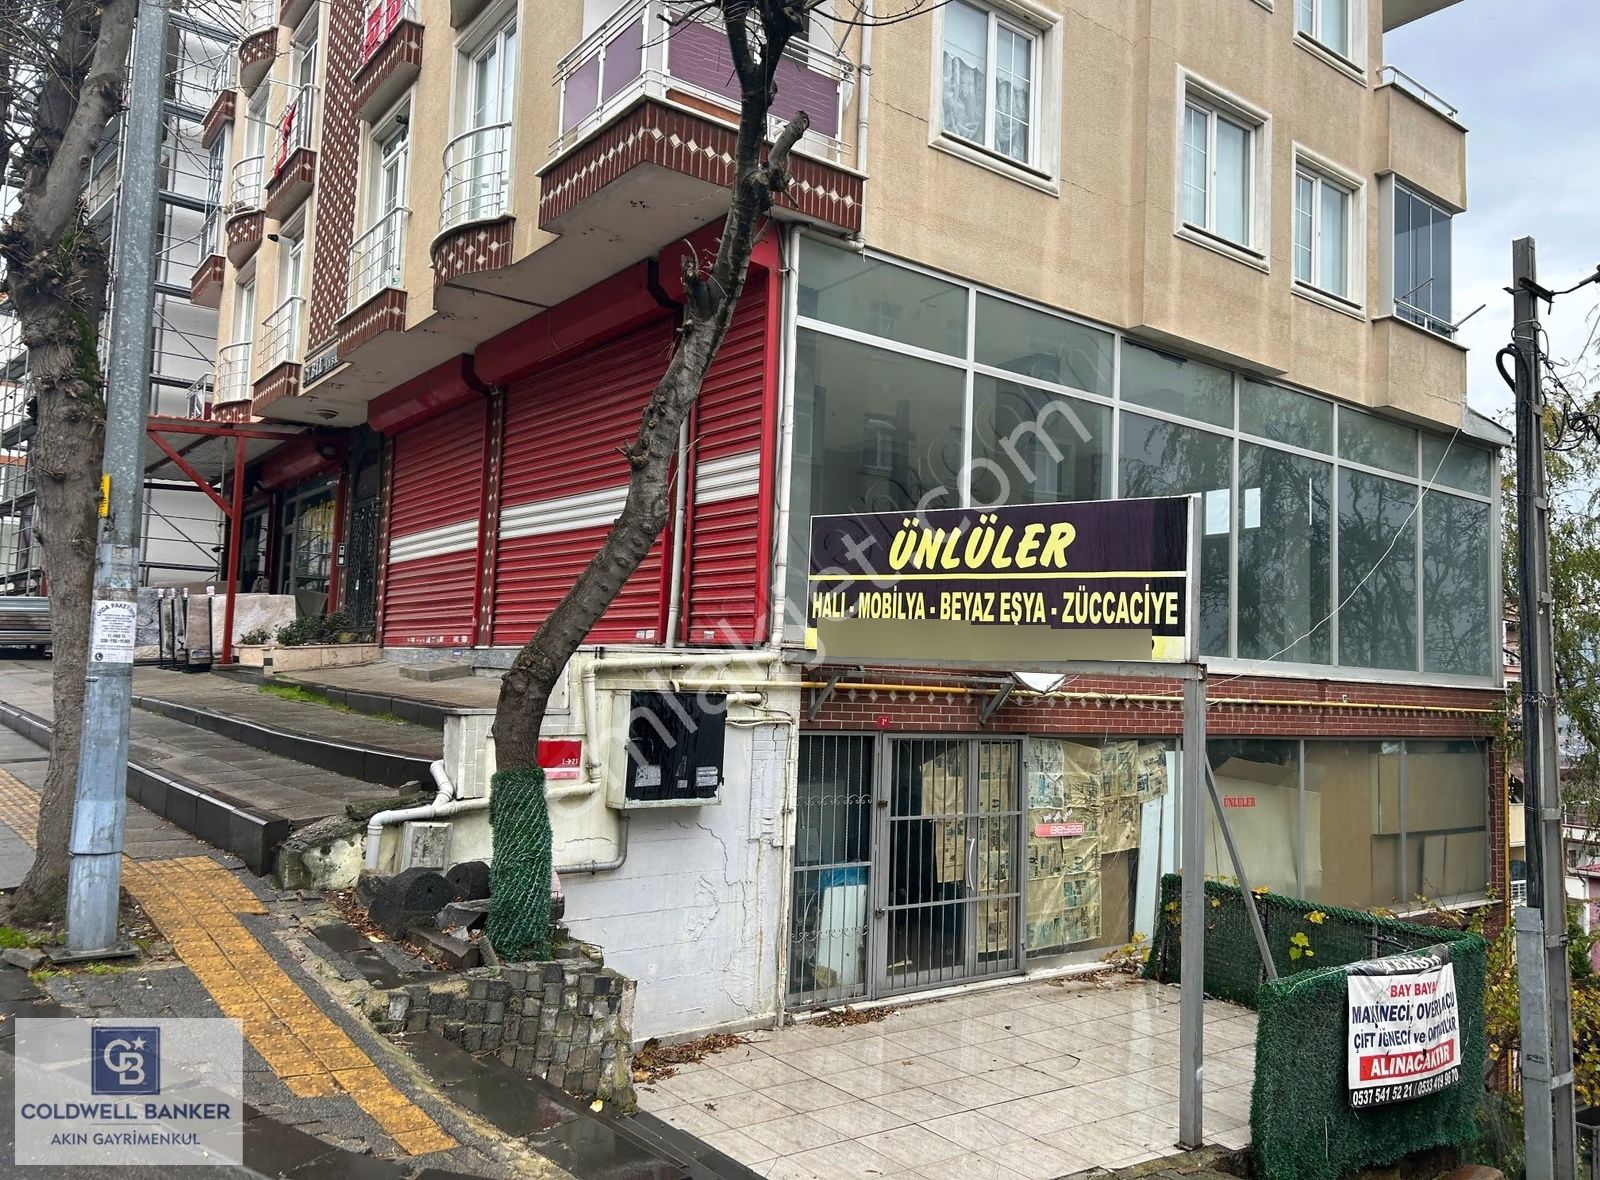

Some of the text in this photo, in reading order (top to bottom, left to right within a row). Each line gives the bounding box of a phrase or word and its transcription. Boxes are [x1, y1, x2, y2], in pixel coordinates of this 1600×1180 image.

[888, 513, 1076, 571] ÜNLÜLER
[812, 591, 846, 619] HALI
[858, 585, 926, 621] MOBİLYA
[940, 591, 995, 622] BEYAZ
[999, 591, 1047, 626] EŞYA
[1062, 584, 1178, 625] ZÜCCACİYE
[1390, 983, 1412, 998] BAY
[1354, 1029, 1376, 1053] ÇİFT
[1413, 1032, 1426, 1043] ve
[1370, 1045, 1450, 1077] ALINACAKTIR
[1352, 1090, 1374, 1106] 0537
[1375, 1088, 1391, 1103] 541
[1392, 1085, 1402, 1100] 52
[1402, 1084, 1412, 1098] 21
